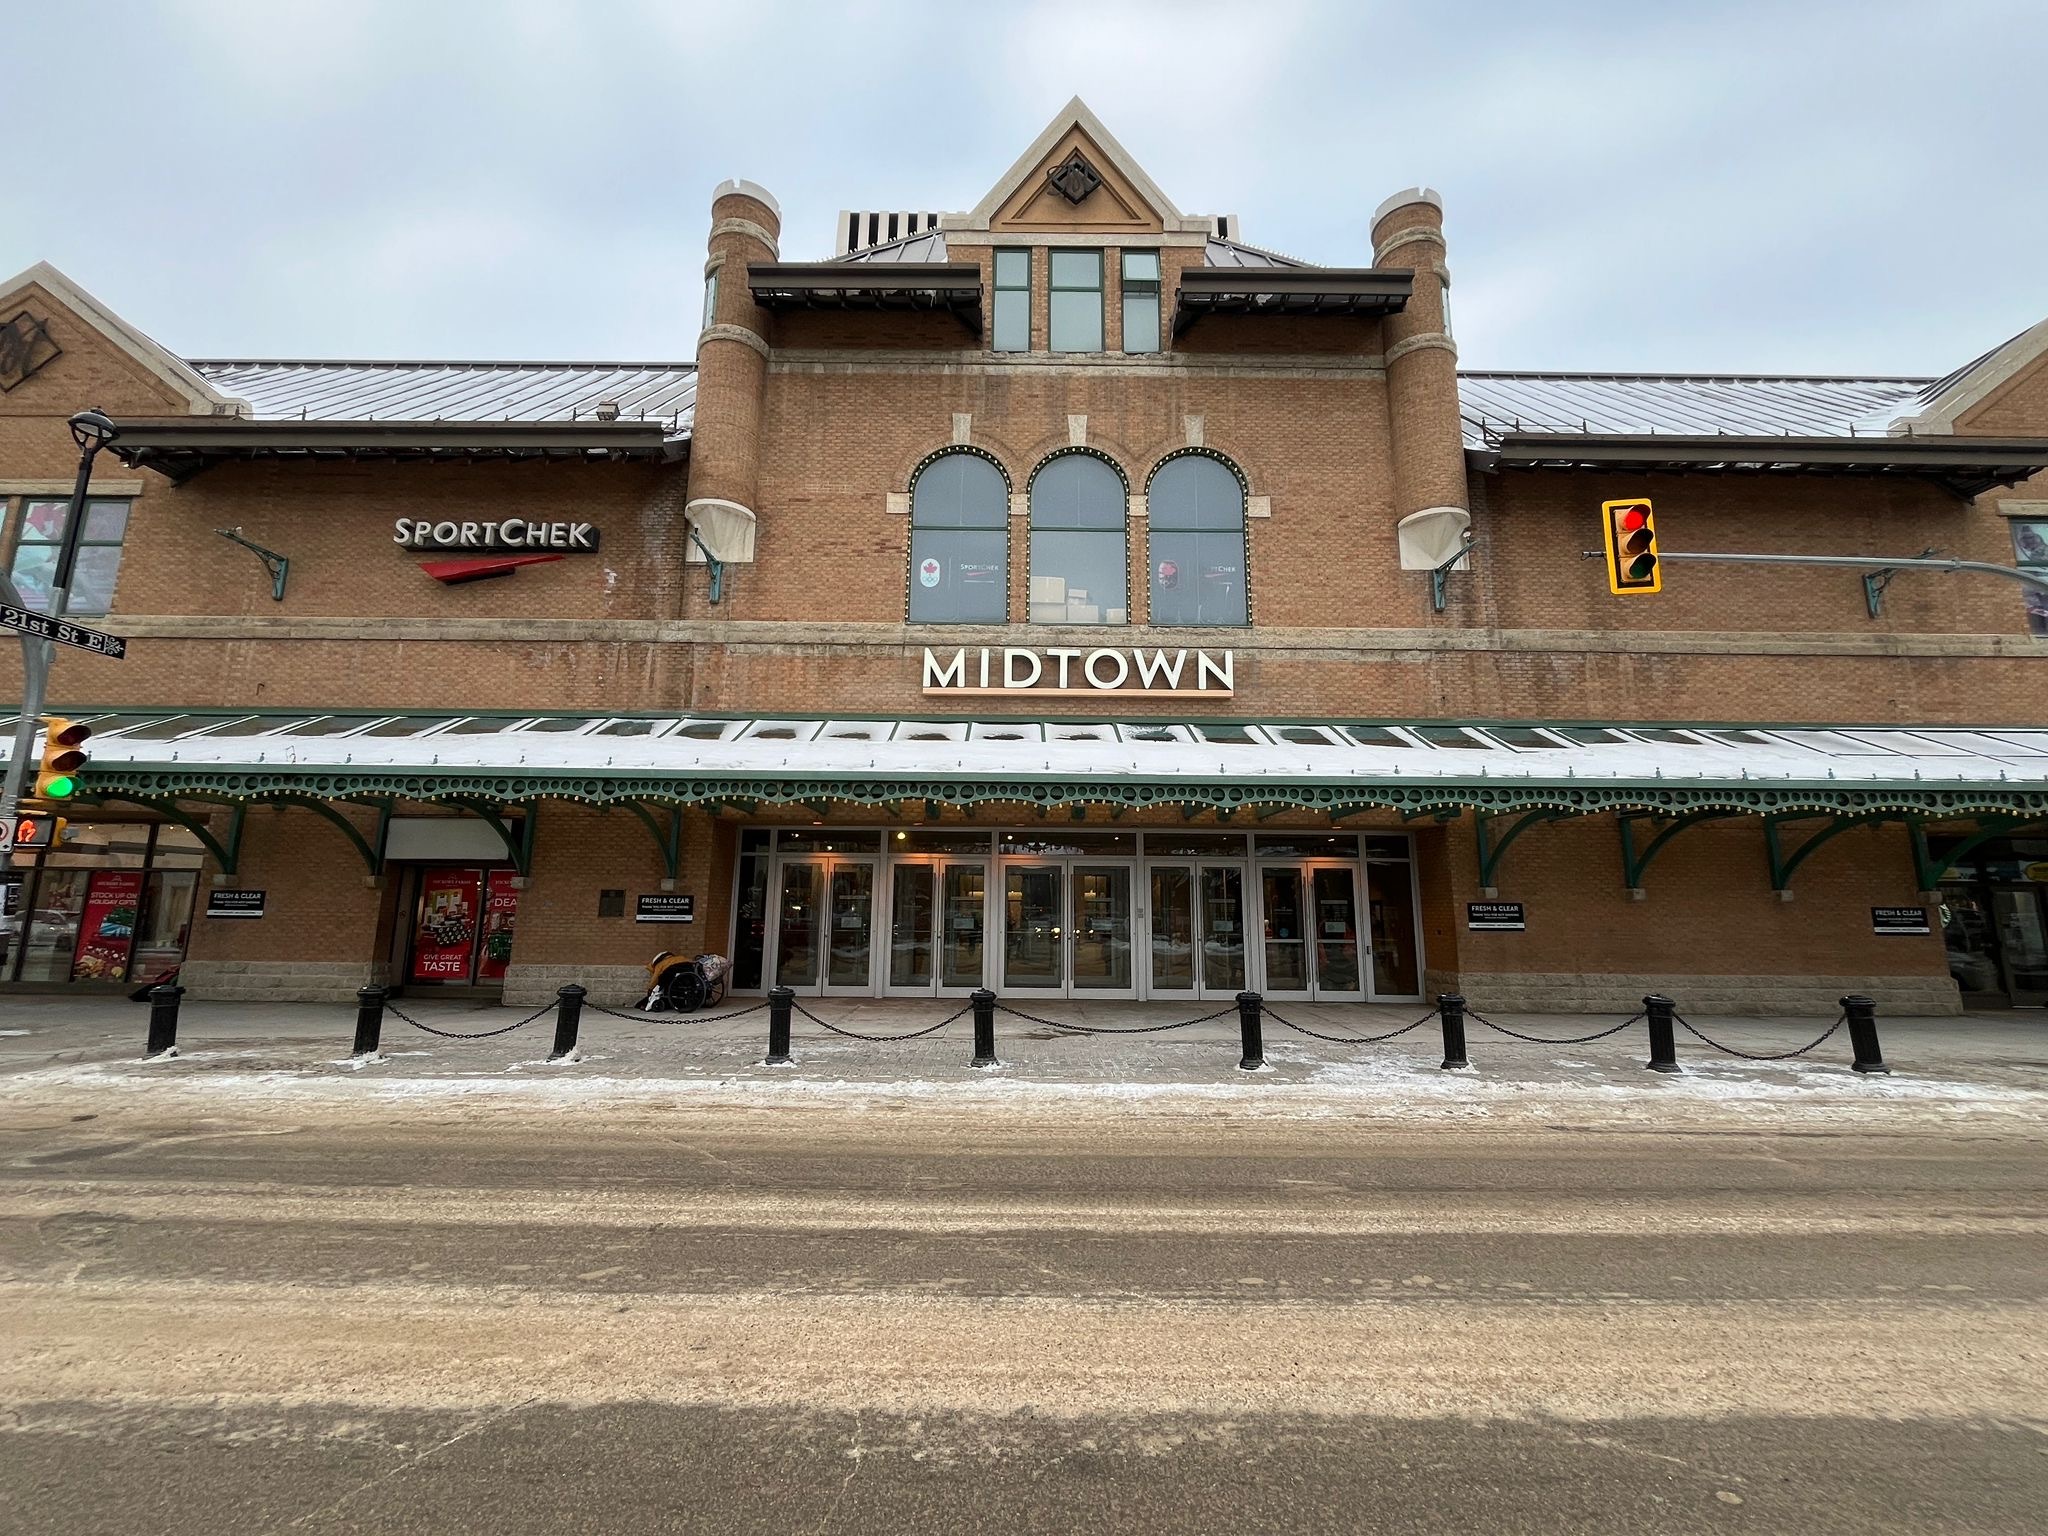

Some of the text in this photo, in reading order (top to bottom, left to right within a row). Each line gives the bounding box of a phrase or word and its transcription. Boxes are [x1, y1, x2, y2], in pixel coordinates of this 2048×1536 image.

[3, 609, 103, 650] 21st St E
[922, 647, 1235, 690] MIDTOWN
[423, 961, 461, 972] TASTE
